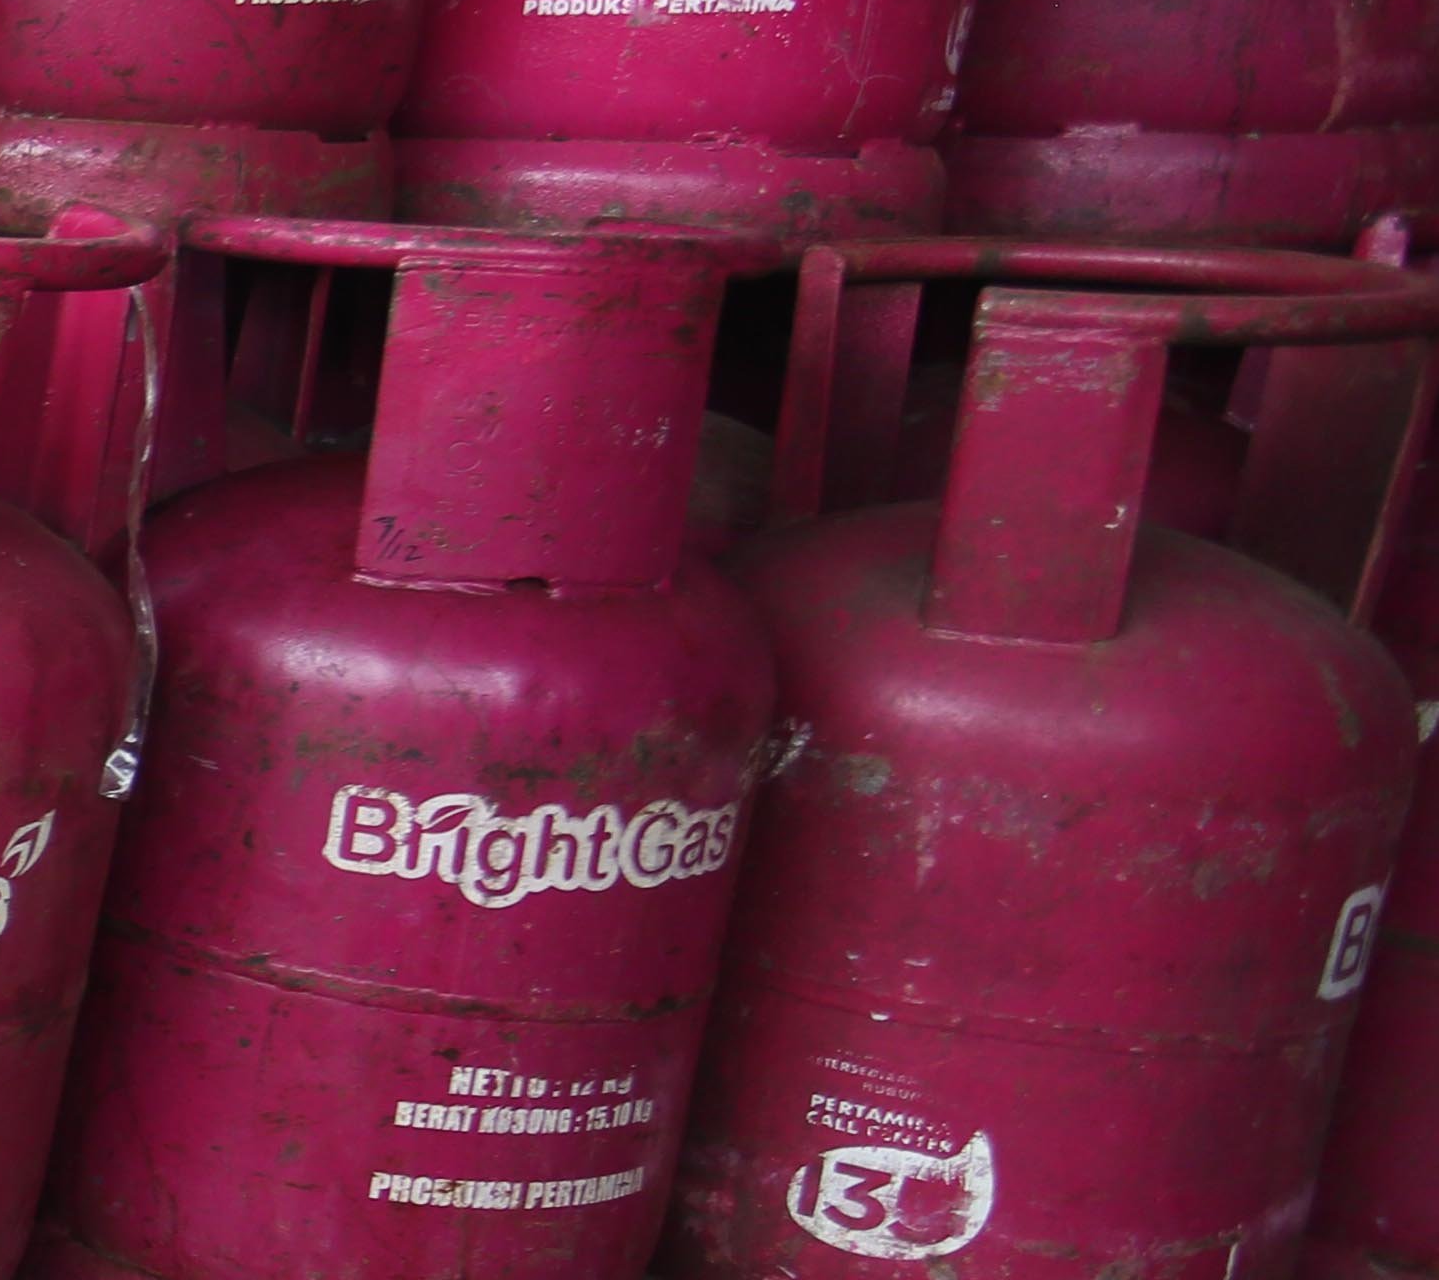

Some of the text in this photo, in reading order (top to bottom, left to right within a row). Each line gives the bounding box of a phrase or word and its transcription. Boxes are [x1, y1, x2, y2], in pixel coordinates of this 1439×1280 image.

[322, 783, 737, 909] Bright Gas
[393, 1100, 477, 1132] BERAT
[477, 1103, 571, 1134] KOSONG
[586, 1101, 631, 1132] 15.10
[805, 1110, 859, 1135] CALL
[523, 1166, 645, 1210] PERTAMINA
